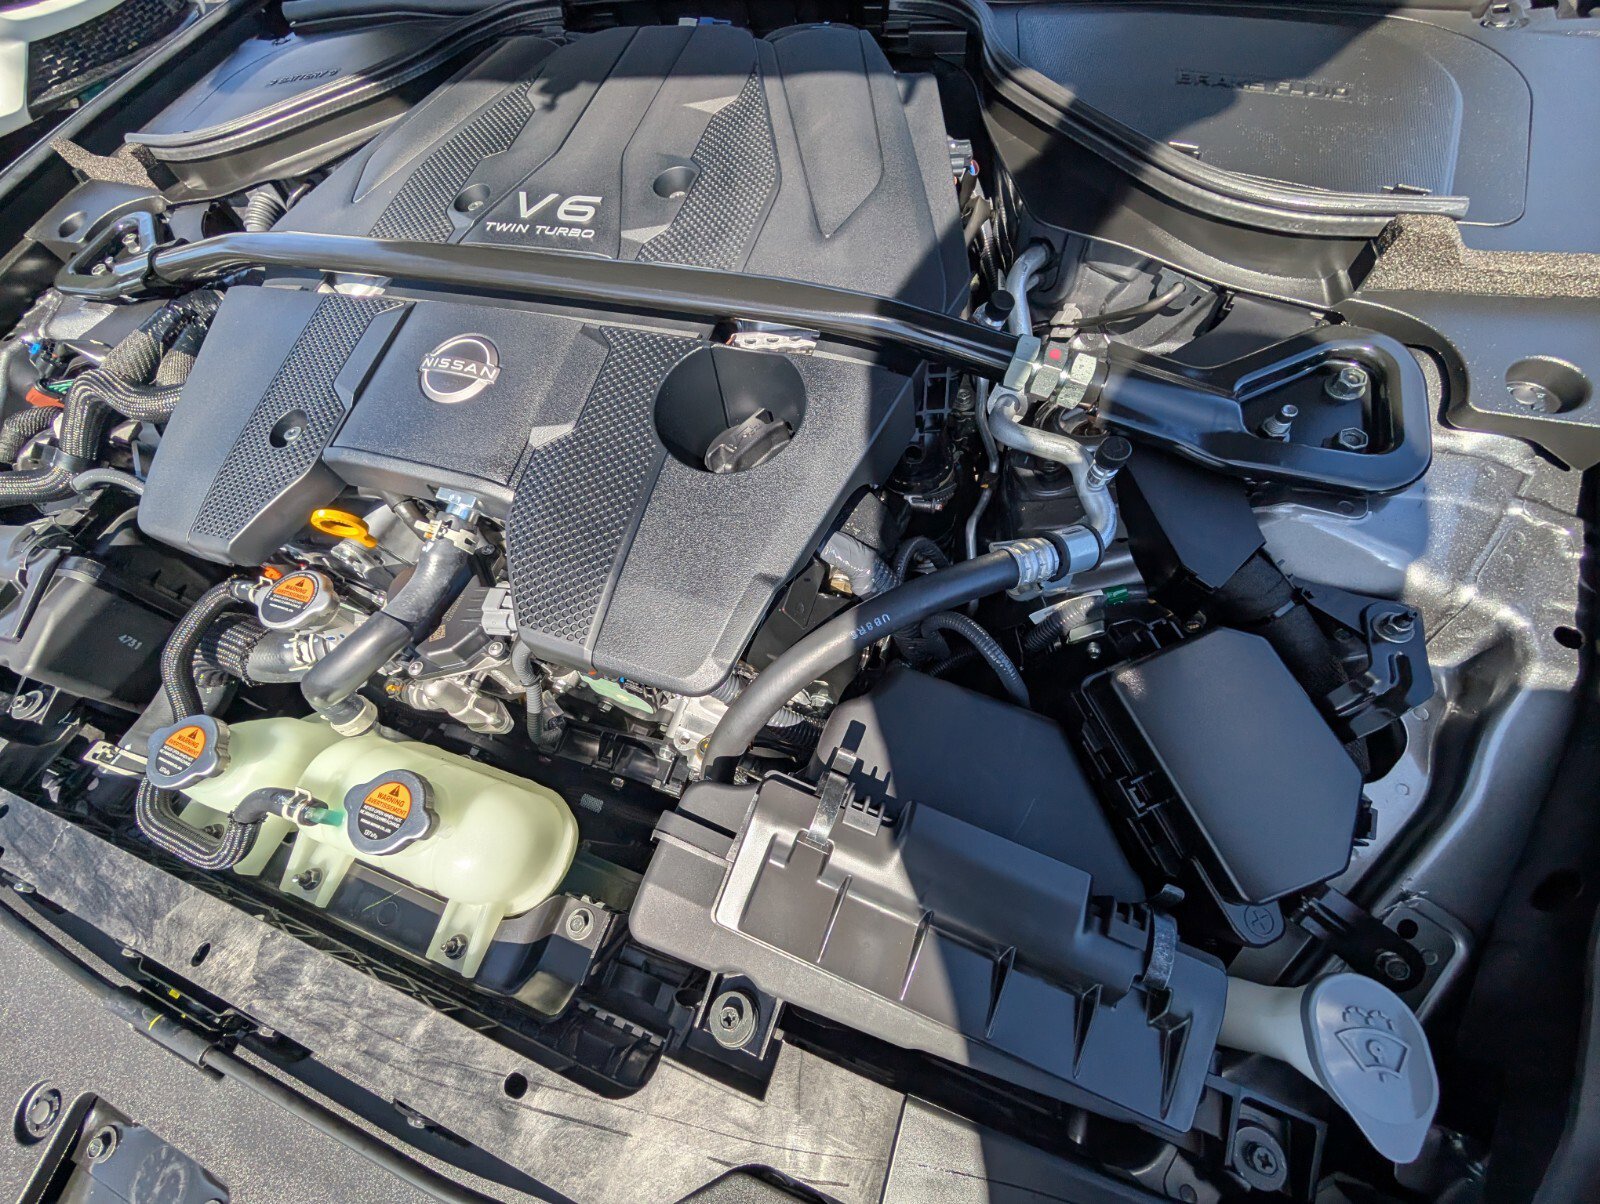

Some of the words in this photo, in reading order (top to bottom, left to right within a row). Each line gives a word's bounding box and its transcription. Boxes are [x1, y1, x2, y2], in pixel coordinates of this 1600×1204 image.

[519, 191, 603, 222] V6
[485, 221, 530, 234] TWIN
[535, 225, 596, 239] TURBO
[421, 357, 497, 379] NISSAN
[168, 738, 199, 756] AVERTISSEMENT
[177, 734, 200, 749] WARNING
[367, 797, 407, 816] AVERTISSEMENT
[377, 792, 405, 808] WARNING
